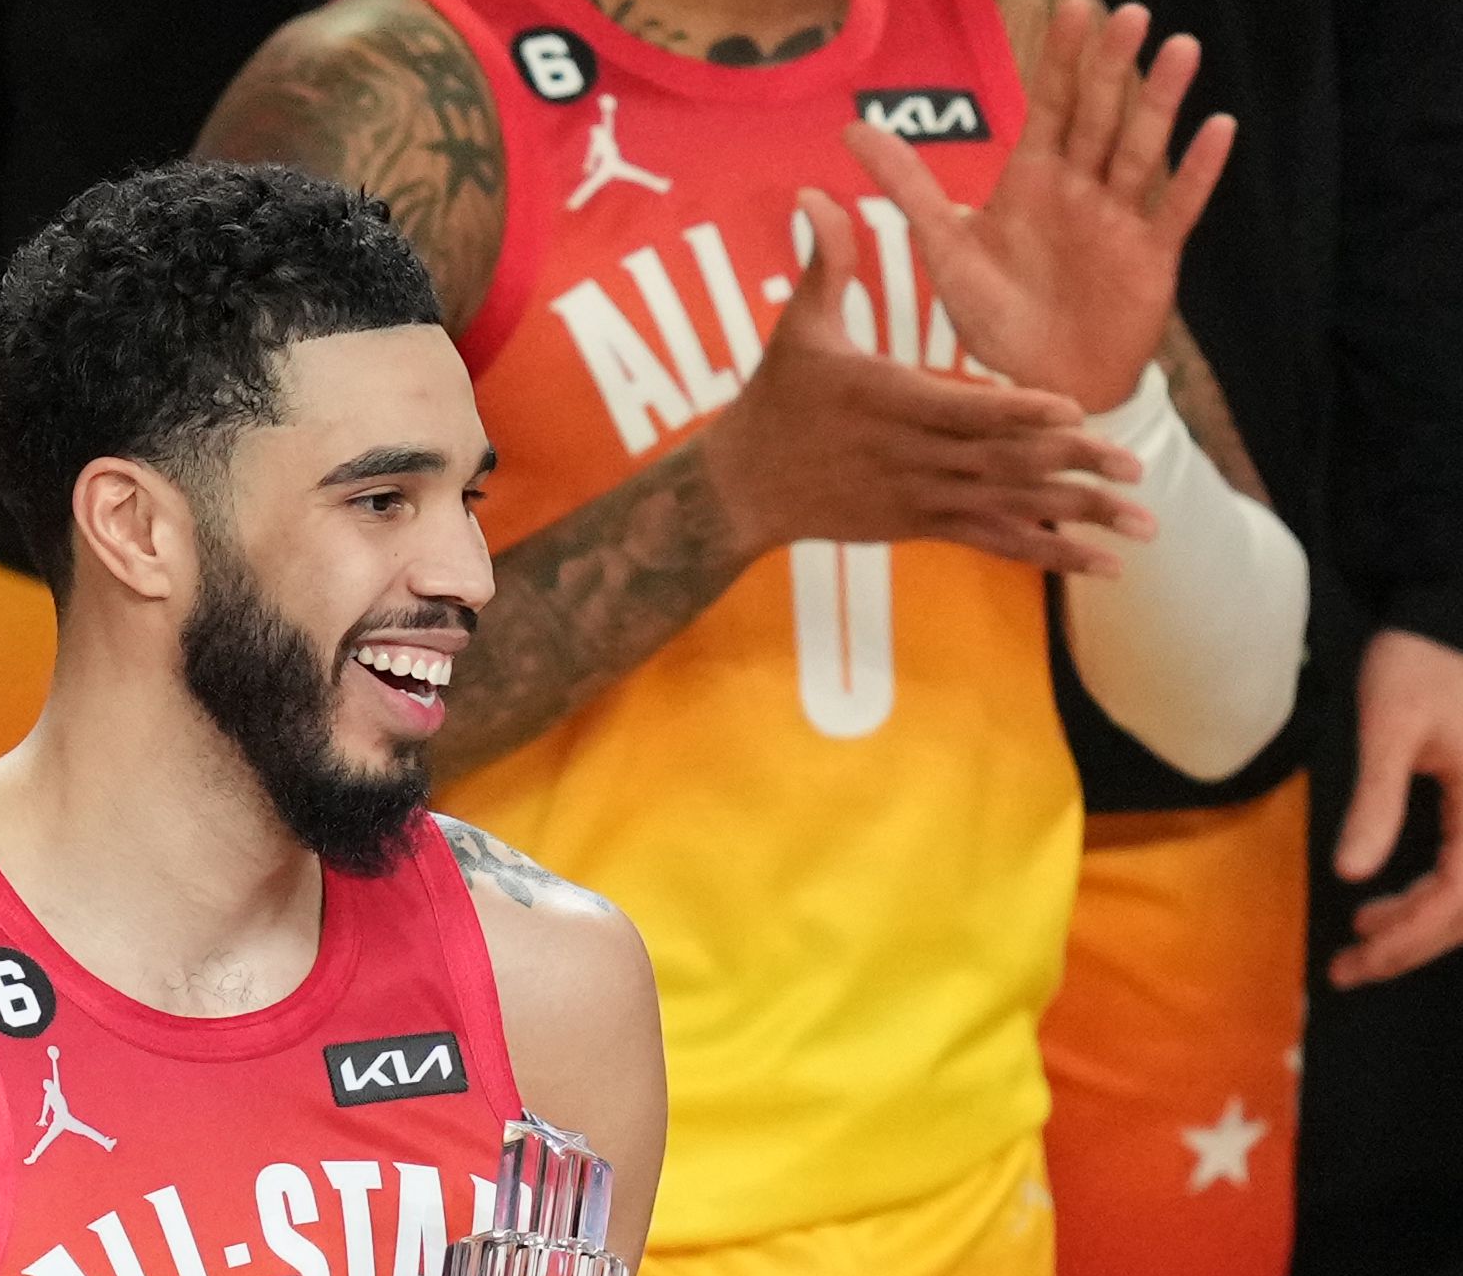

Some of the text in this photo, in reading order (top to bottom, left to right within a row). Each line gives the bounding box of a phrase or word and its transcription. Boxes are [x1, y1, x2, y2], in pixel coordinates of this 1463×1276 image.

[520, 32, 583, 99] 6
[865, 95, 978, 136] KIA
[340, 1045, 454, 1092] KIA
